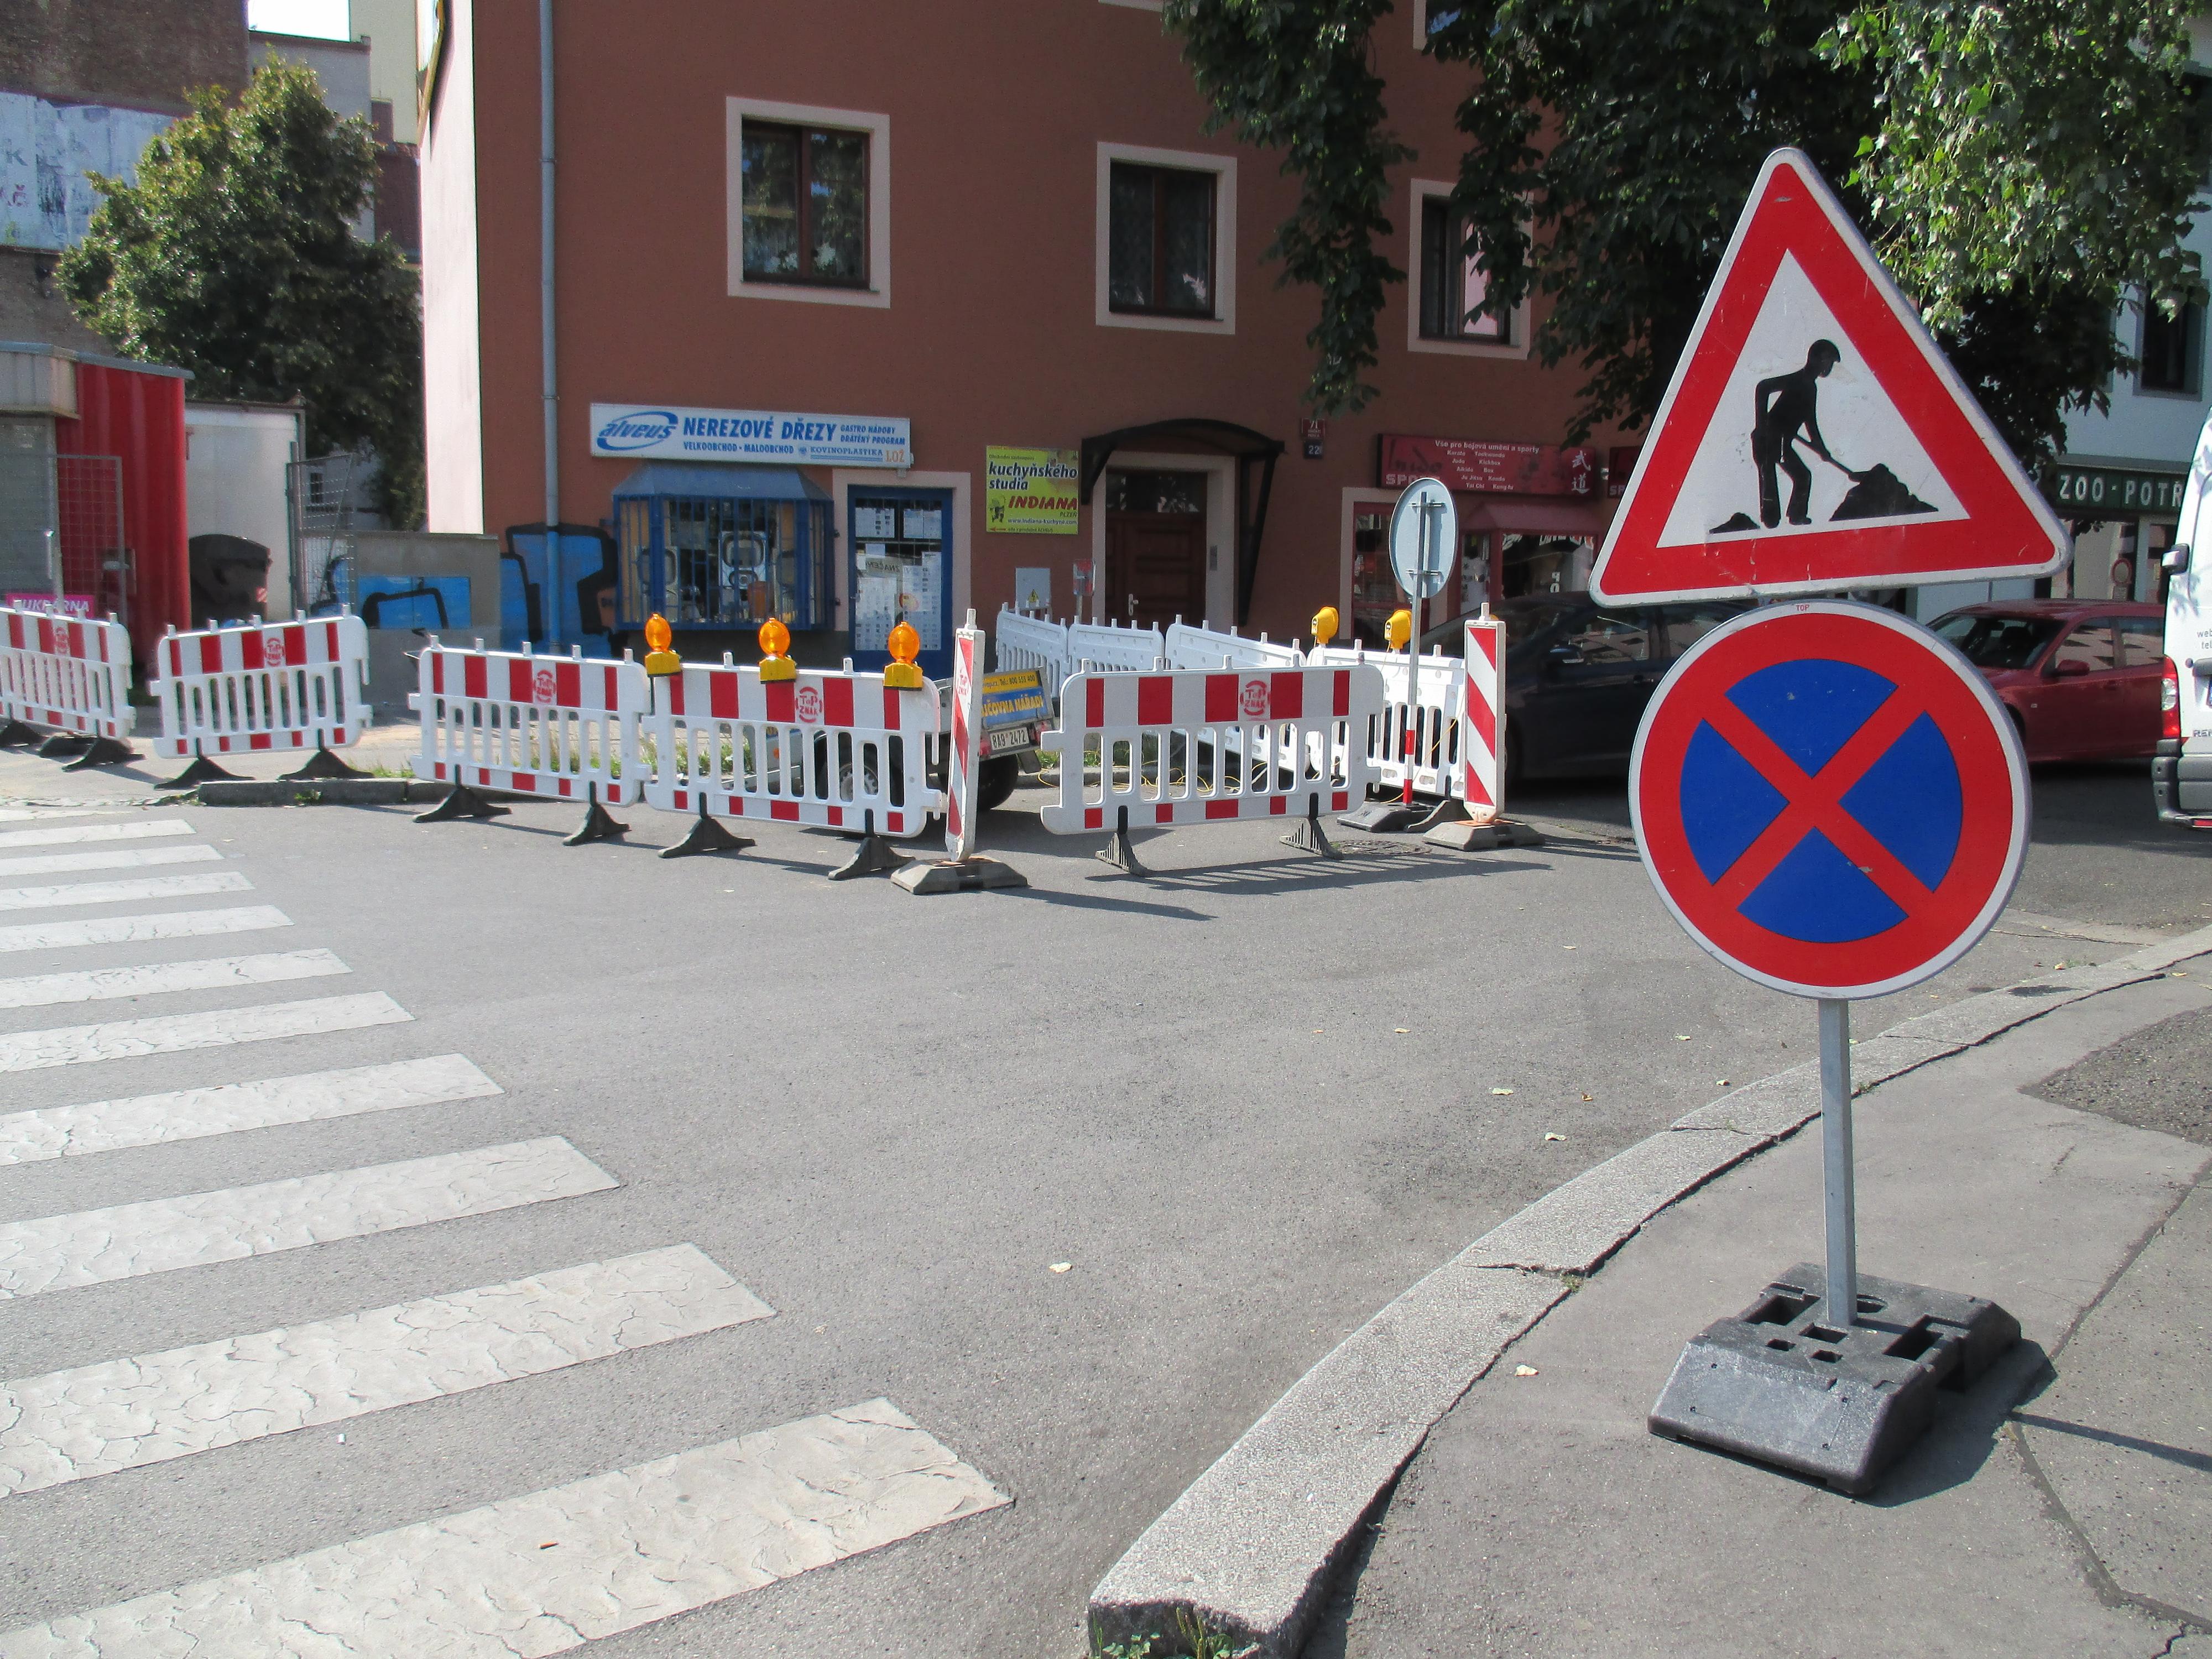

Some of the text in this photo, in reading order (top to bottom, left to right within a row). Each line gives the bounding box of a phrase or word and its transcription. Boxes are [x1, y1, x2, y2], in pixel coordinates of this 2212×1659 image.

[599, 420, 676, 439] alveus
[684, 416, 837, 441] NEREZOVÉ DŘEZY
[841, 424, 896, 435] GASTRO NÁDOBY
[684, 441, 794, 453] VELKOOBCHOD MALOOBCHOD
[872, 436, 905, 445] PROGRAM
[810, 446, 883, 456] KOVINOPLASTIKA
[1464, 442, 1486, 450] bojová
[1517, 446, 1540, 455] sporty
[989, 461, 1078, 480] kuchyňského
[989, 477, 1028, 490] studia
[2059, 474, 2105, 502] ZOO
[1008, 495, 1077, 510] INDIANA
[1015, 692, 1044, 711] NÁŘADÍ
[992, 729, 1026, 748] 8A9 2472
